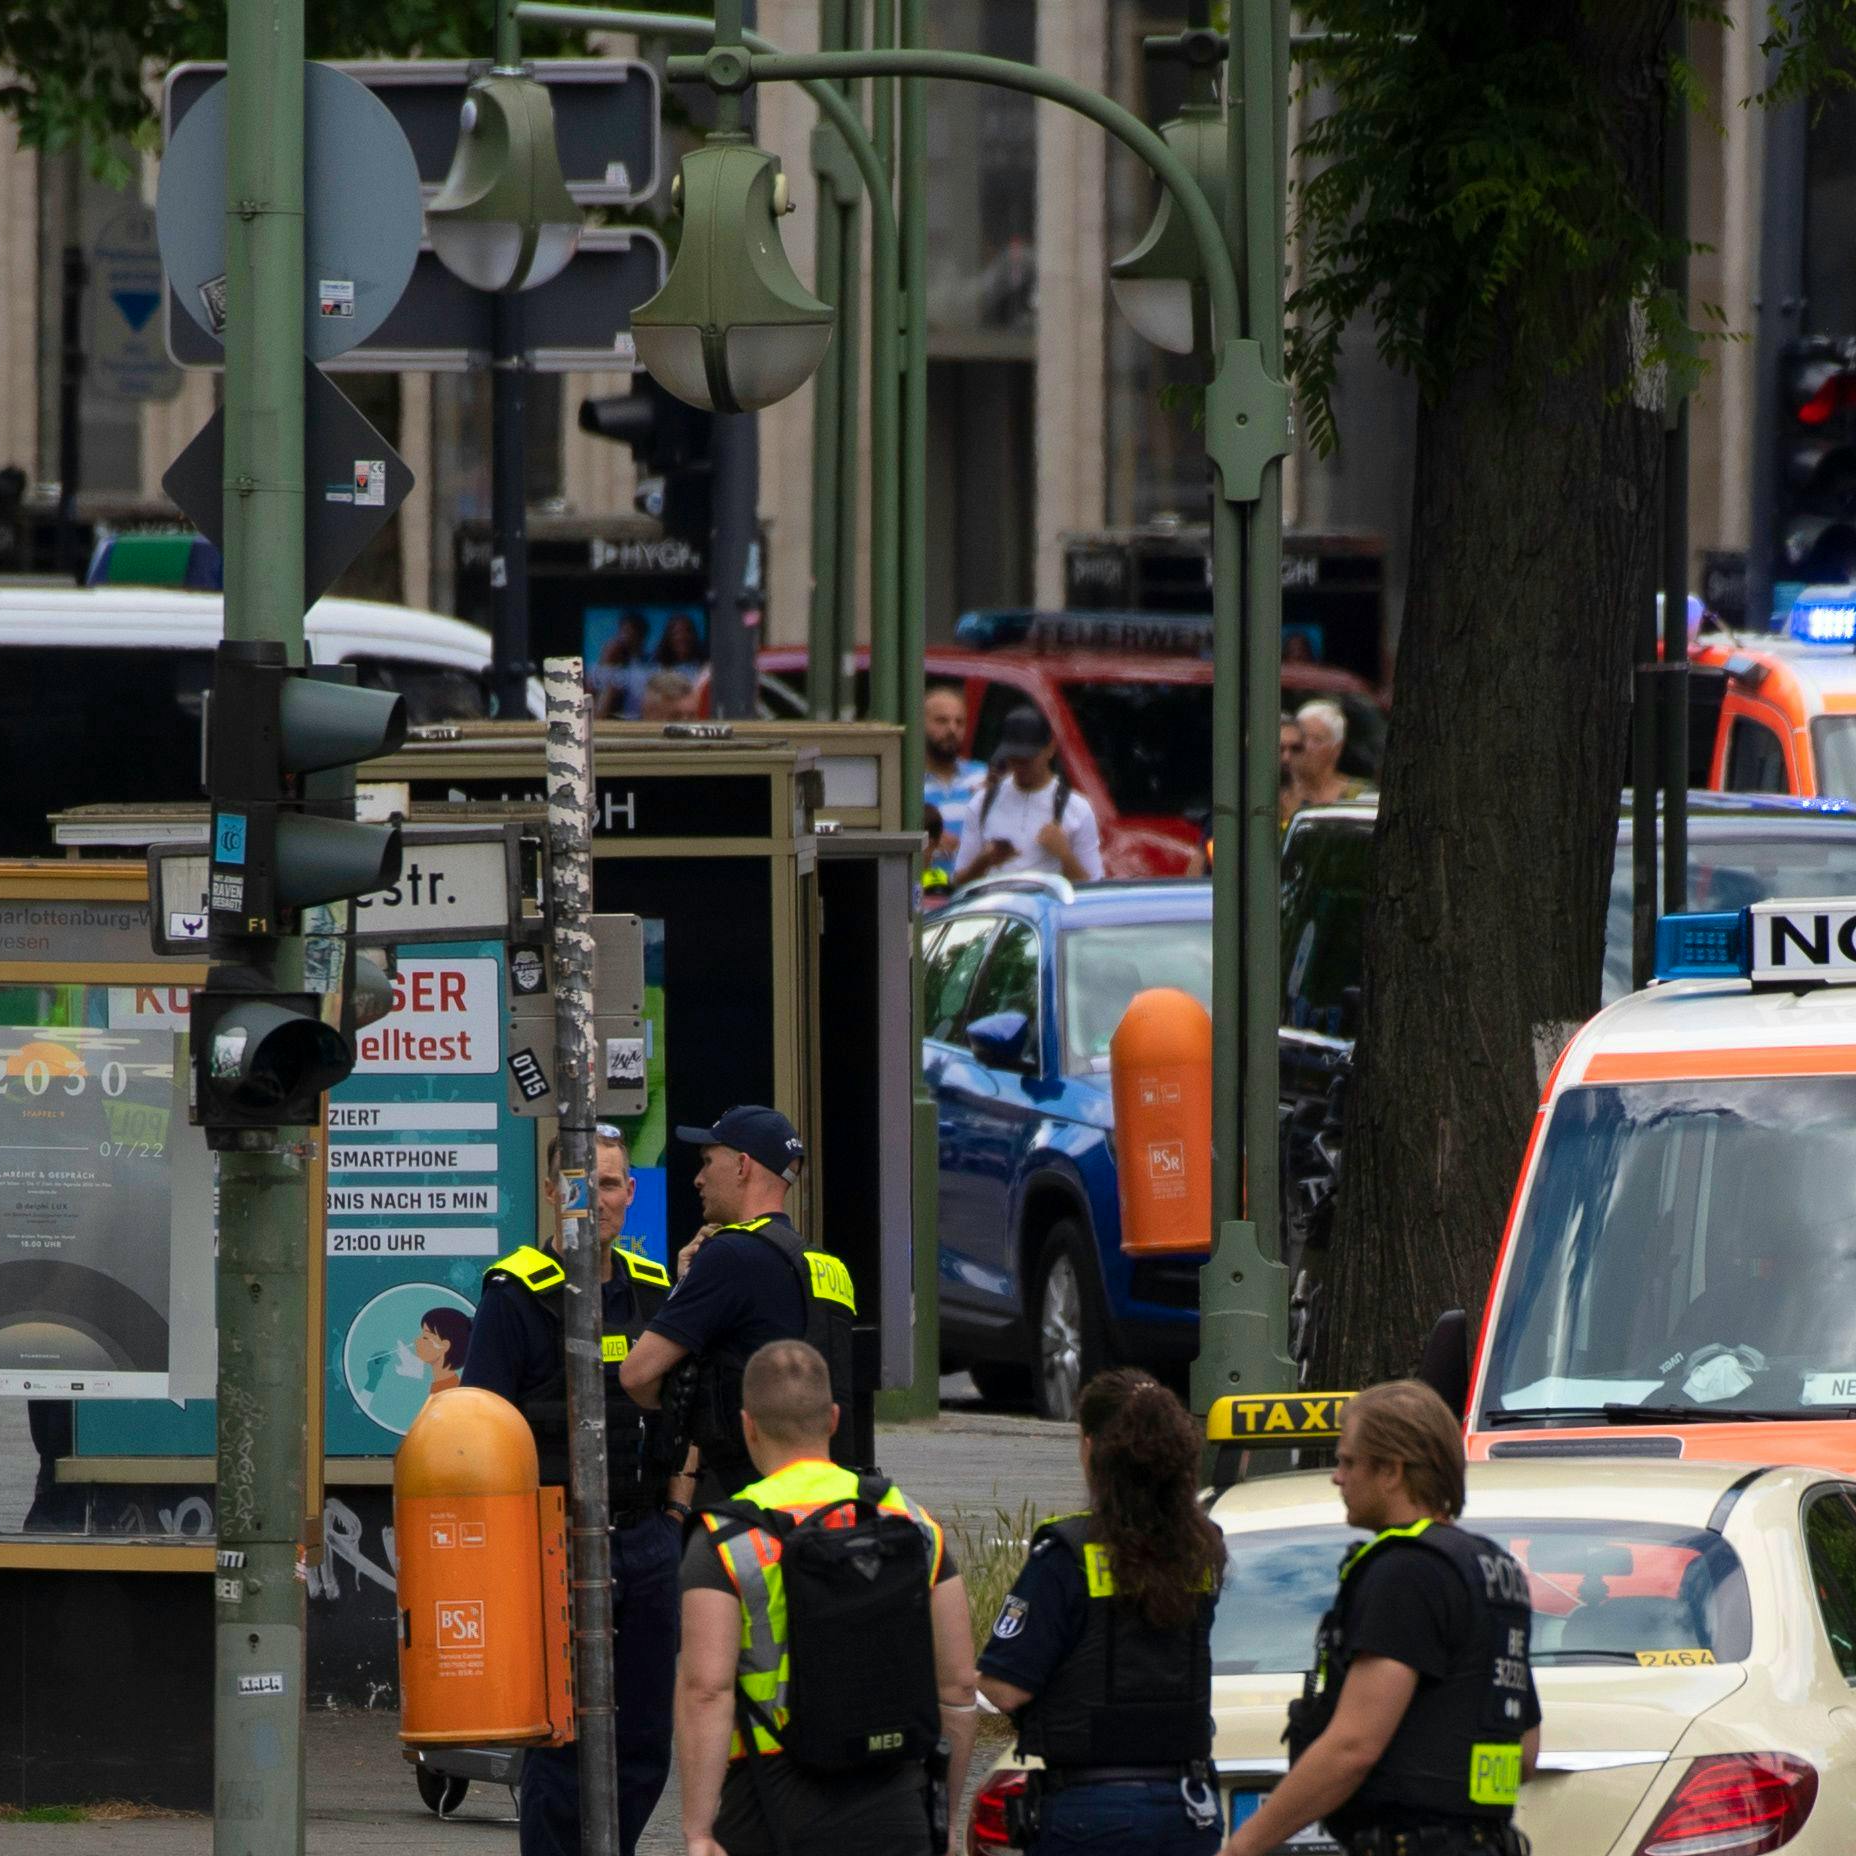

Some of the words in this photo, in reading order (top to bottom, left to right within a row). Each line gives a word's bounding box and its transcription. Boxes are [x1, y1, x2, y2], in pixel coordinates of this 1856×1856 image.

[248, 918, 268, 933] F1
[356, 1029, 473, 1062] elltest
[511, 1053, 547, 1096] 0115
[329, 1109, 380, 1126] ZIERT
[99, 1141, 164, 1158] 07/22
[331, 1151, 458, 1167] SMARTPHONE
[1152, 1148, 1180, 1171] BSR
[371, 1193, 421, 1210] NACH
[428, 1192, 446, 1209] 15
[453, 1192, 488, 1209] MIN
[334, 1235, 381, 1251] 21:00
[387, 1234, 426, 1251] UHR
[441, 1609, 480, 1640] BSR
[869, 1732, 903, 1751] MED
